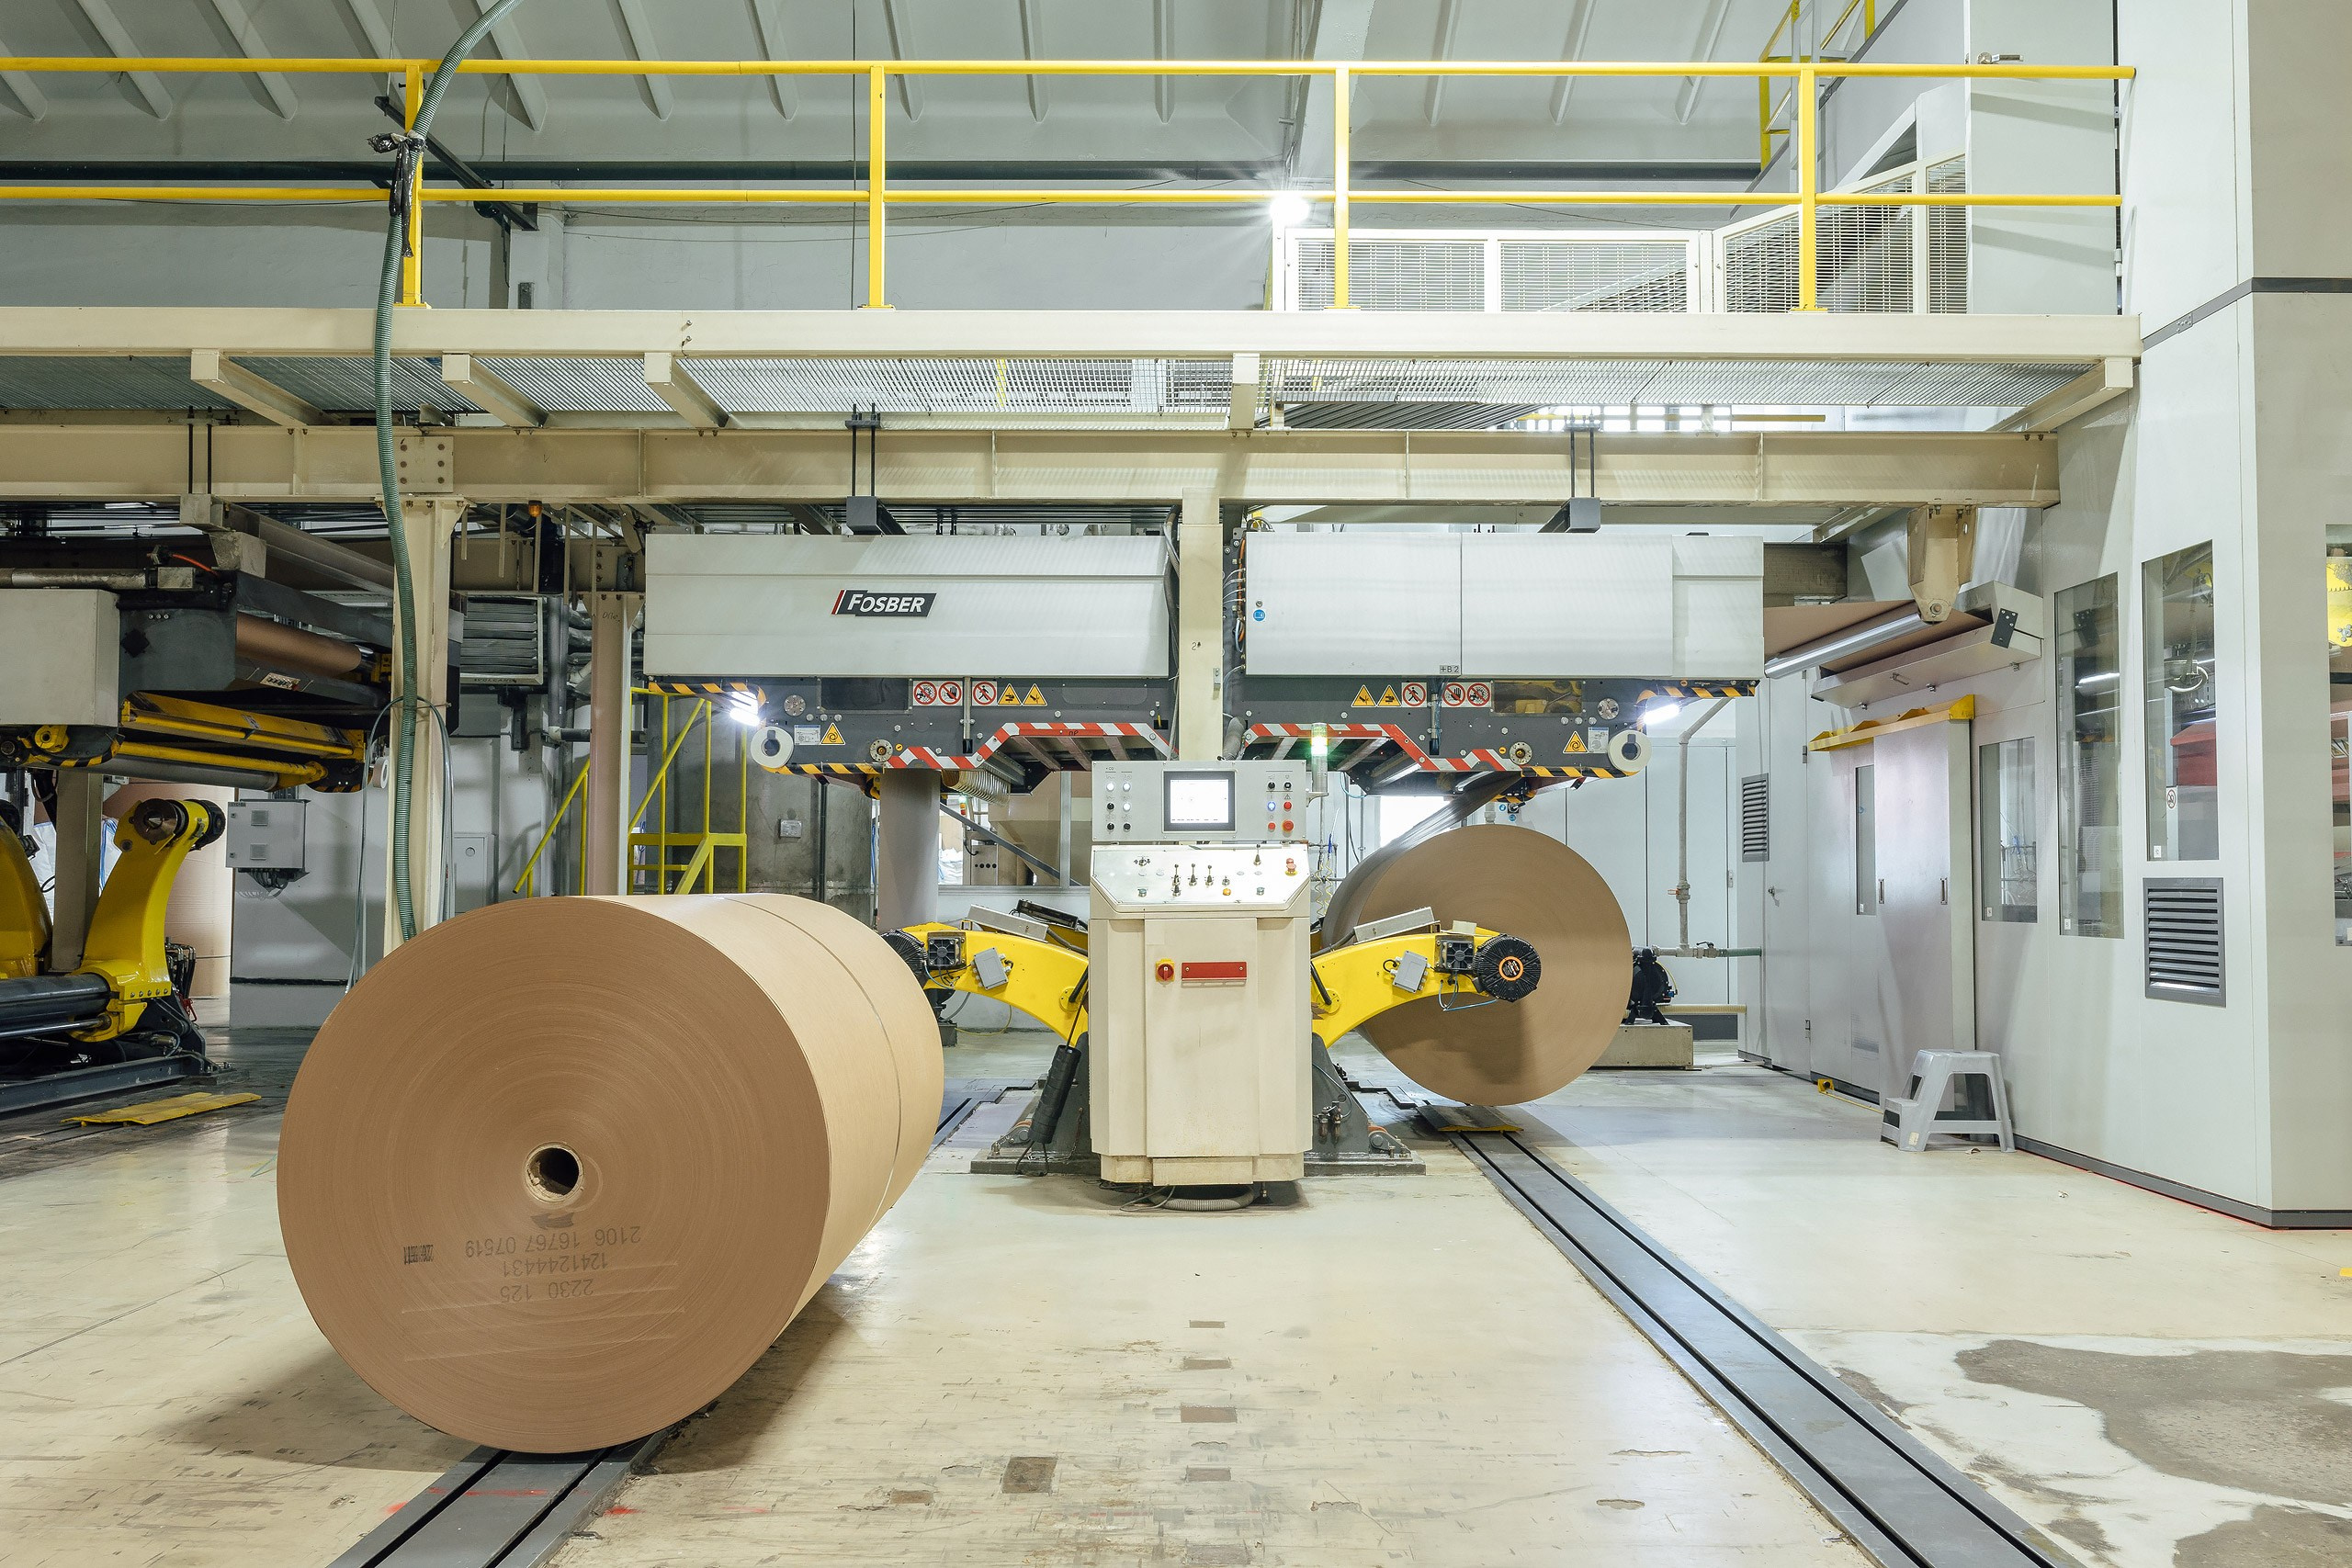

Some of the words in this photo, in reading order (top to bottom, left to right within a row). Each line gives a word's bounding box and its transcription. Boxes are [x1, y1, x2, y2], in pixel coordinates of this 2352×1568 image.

[847, 594, 925, 612] FOSBER
[525, 1232, 580, 1253] 16767
[594, 1226, 641, 1246] 2106
[465, 1236, 516, 1258] 07519
[503, 1252, 608, 1278] 1241244431
[500, 1285, 533, 1303] 125
[548, 1278, 595, 1299] 2230
